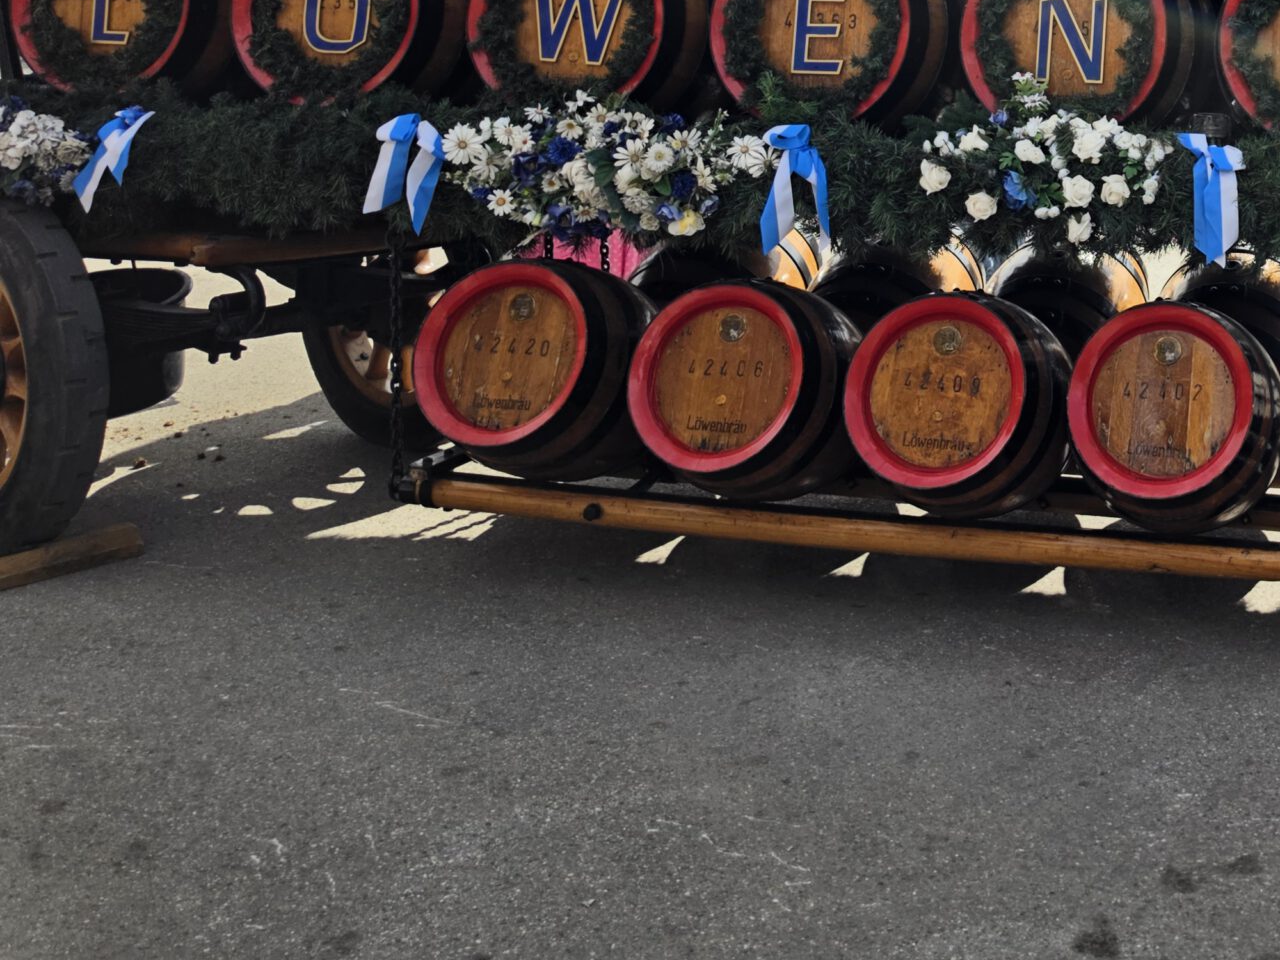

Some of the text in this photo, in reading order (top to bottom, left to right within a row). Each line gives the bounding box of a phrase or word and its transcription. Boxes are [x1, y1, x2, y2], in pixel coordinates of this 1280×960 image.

[473, 337, 550, 357] 42420
[688, 358, 764, 378] 42406
[686, 414, 748, 434] Löwenbräu
[902, 430, 965, 452] Löwenbräu
